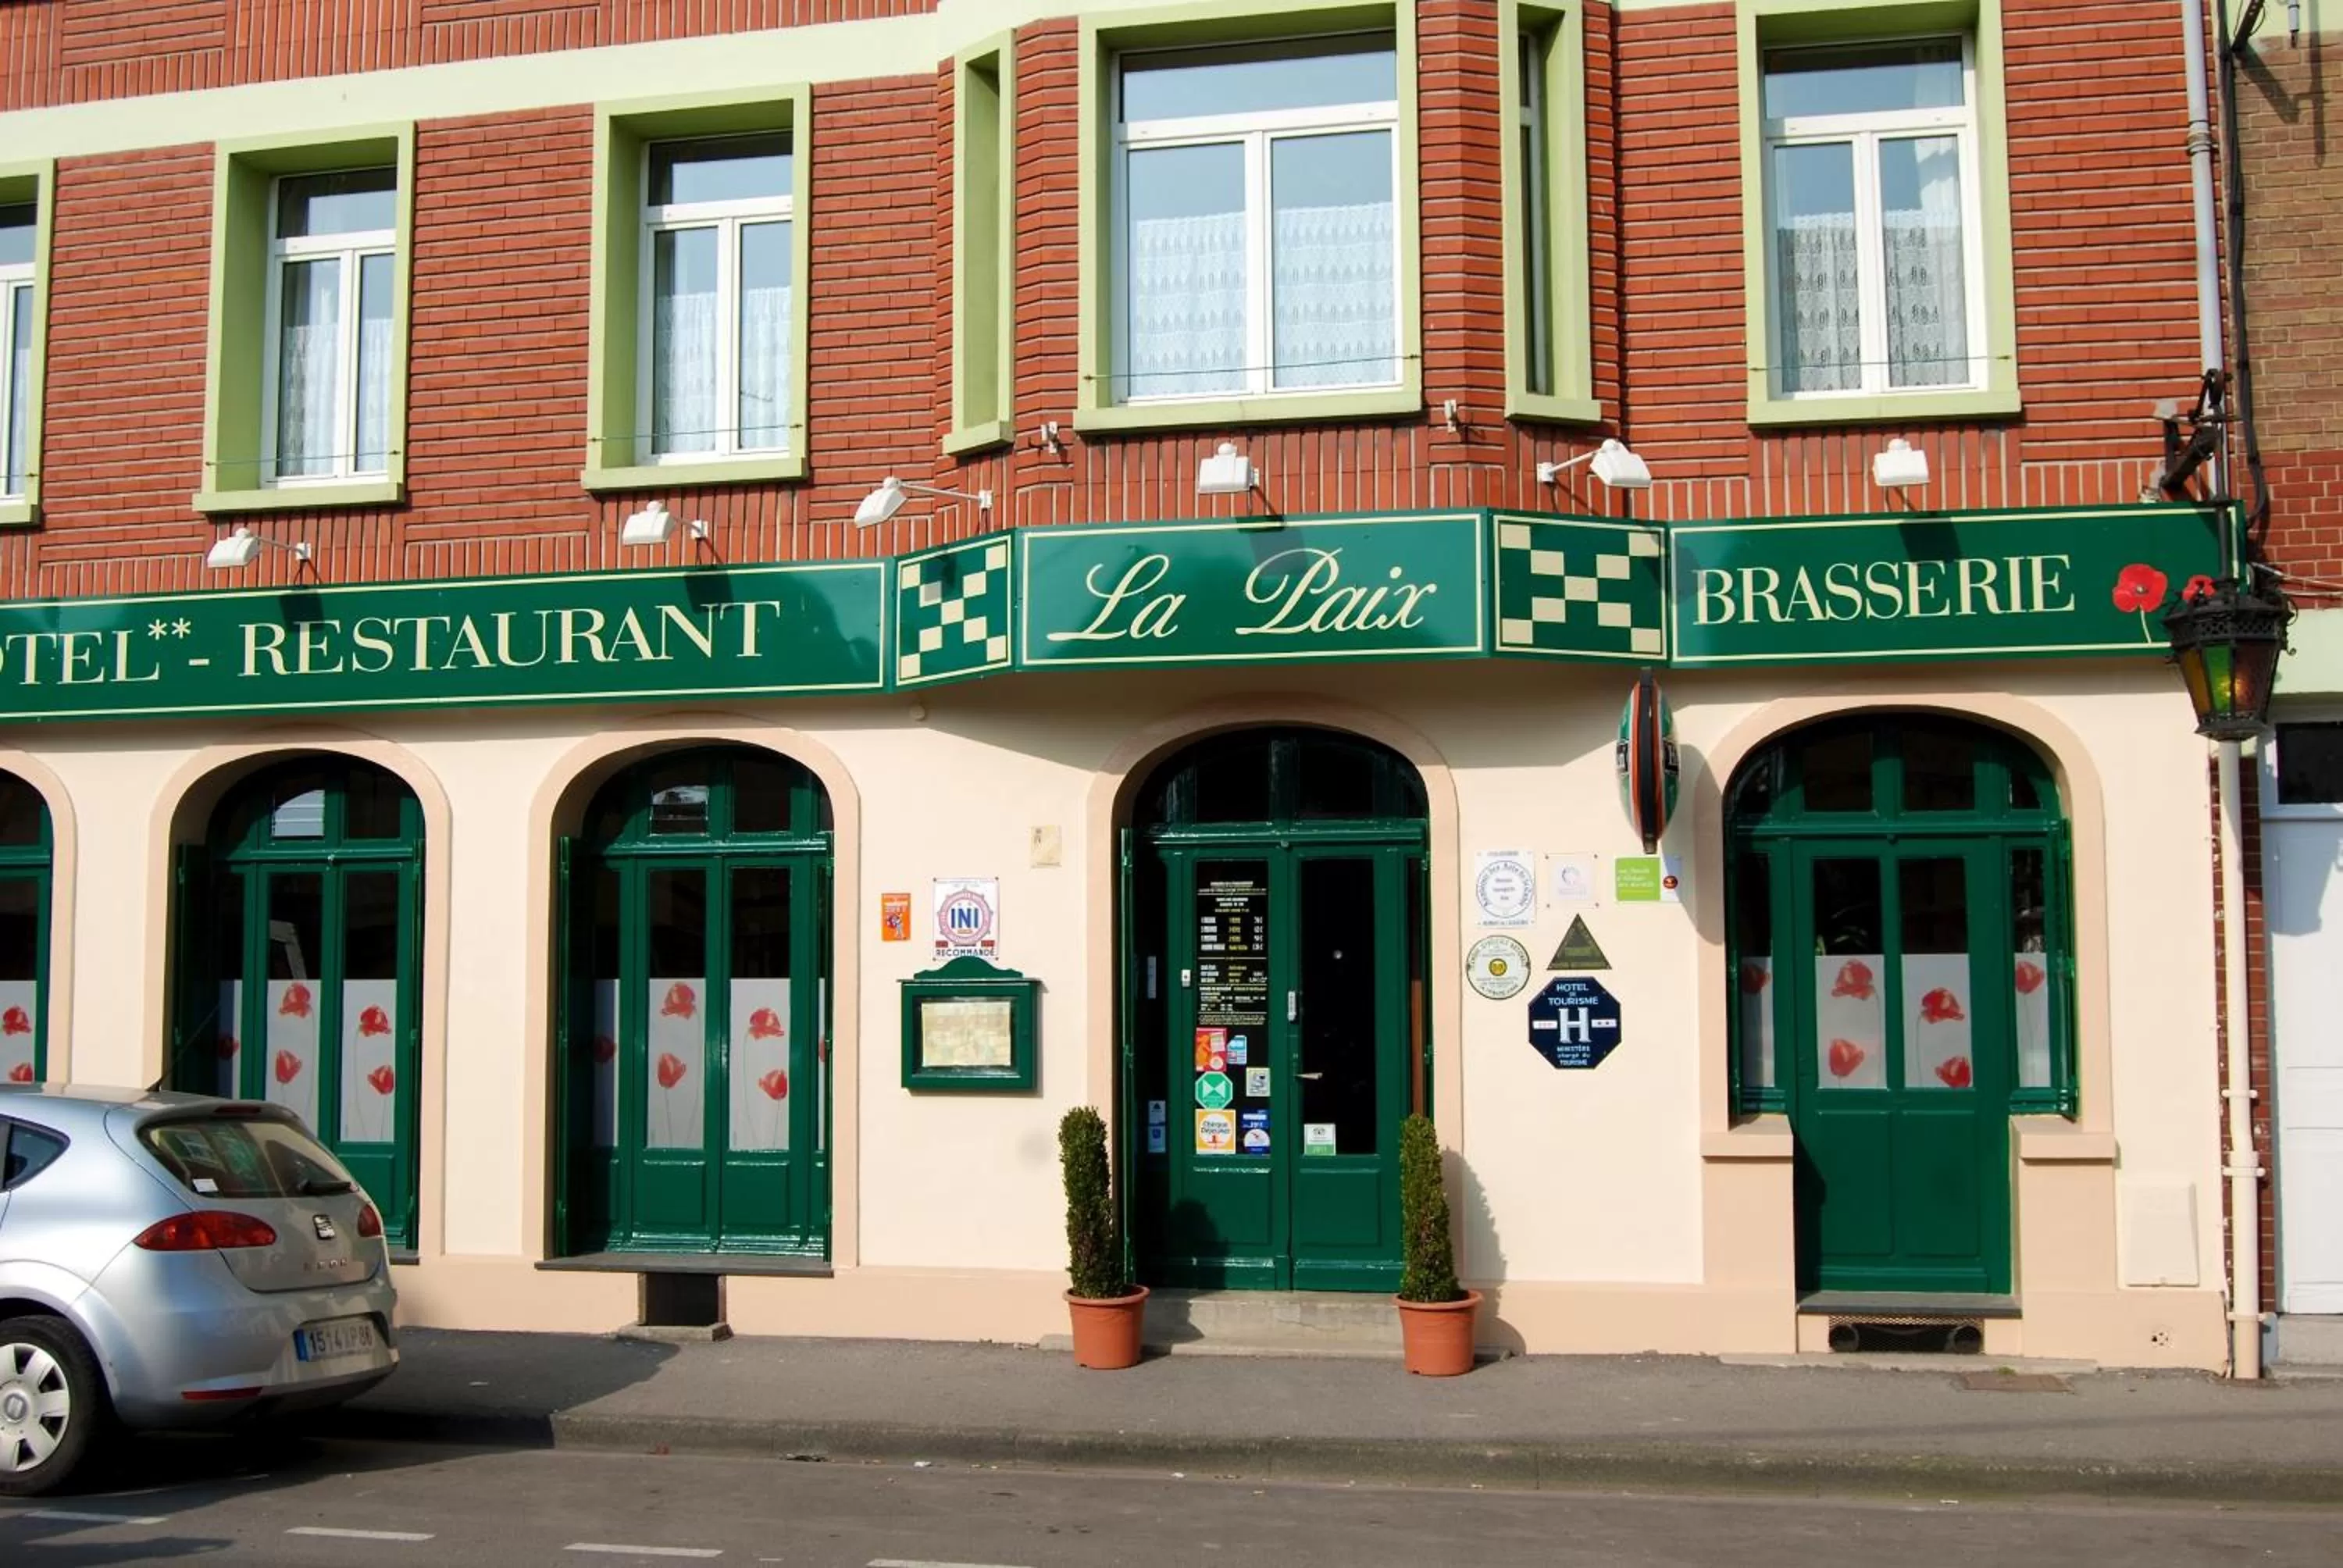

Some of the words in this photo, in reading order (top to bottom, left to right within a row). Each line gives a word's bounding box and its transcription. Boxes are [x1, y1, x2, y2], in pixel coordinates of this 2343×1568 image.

[1047, 554, 1186, 641] La
[1235, 547, 1436, 634] Paix
[1692, 554, 2074, 625] BRASSERIE
[238, 600, 780, 677] RESTAURANT
[1548, 997, 1599, 1006] TOURISME
[1558, 1007, 1592, 1044] H
